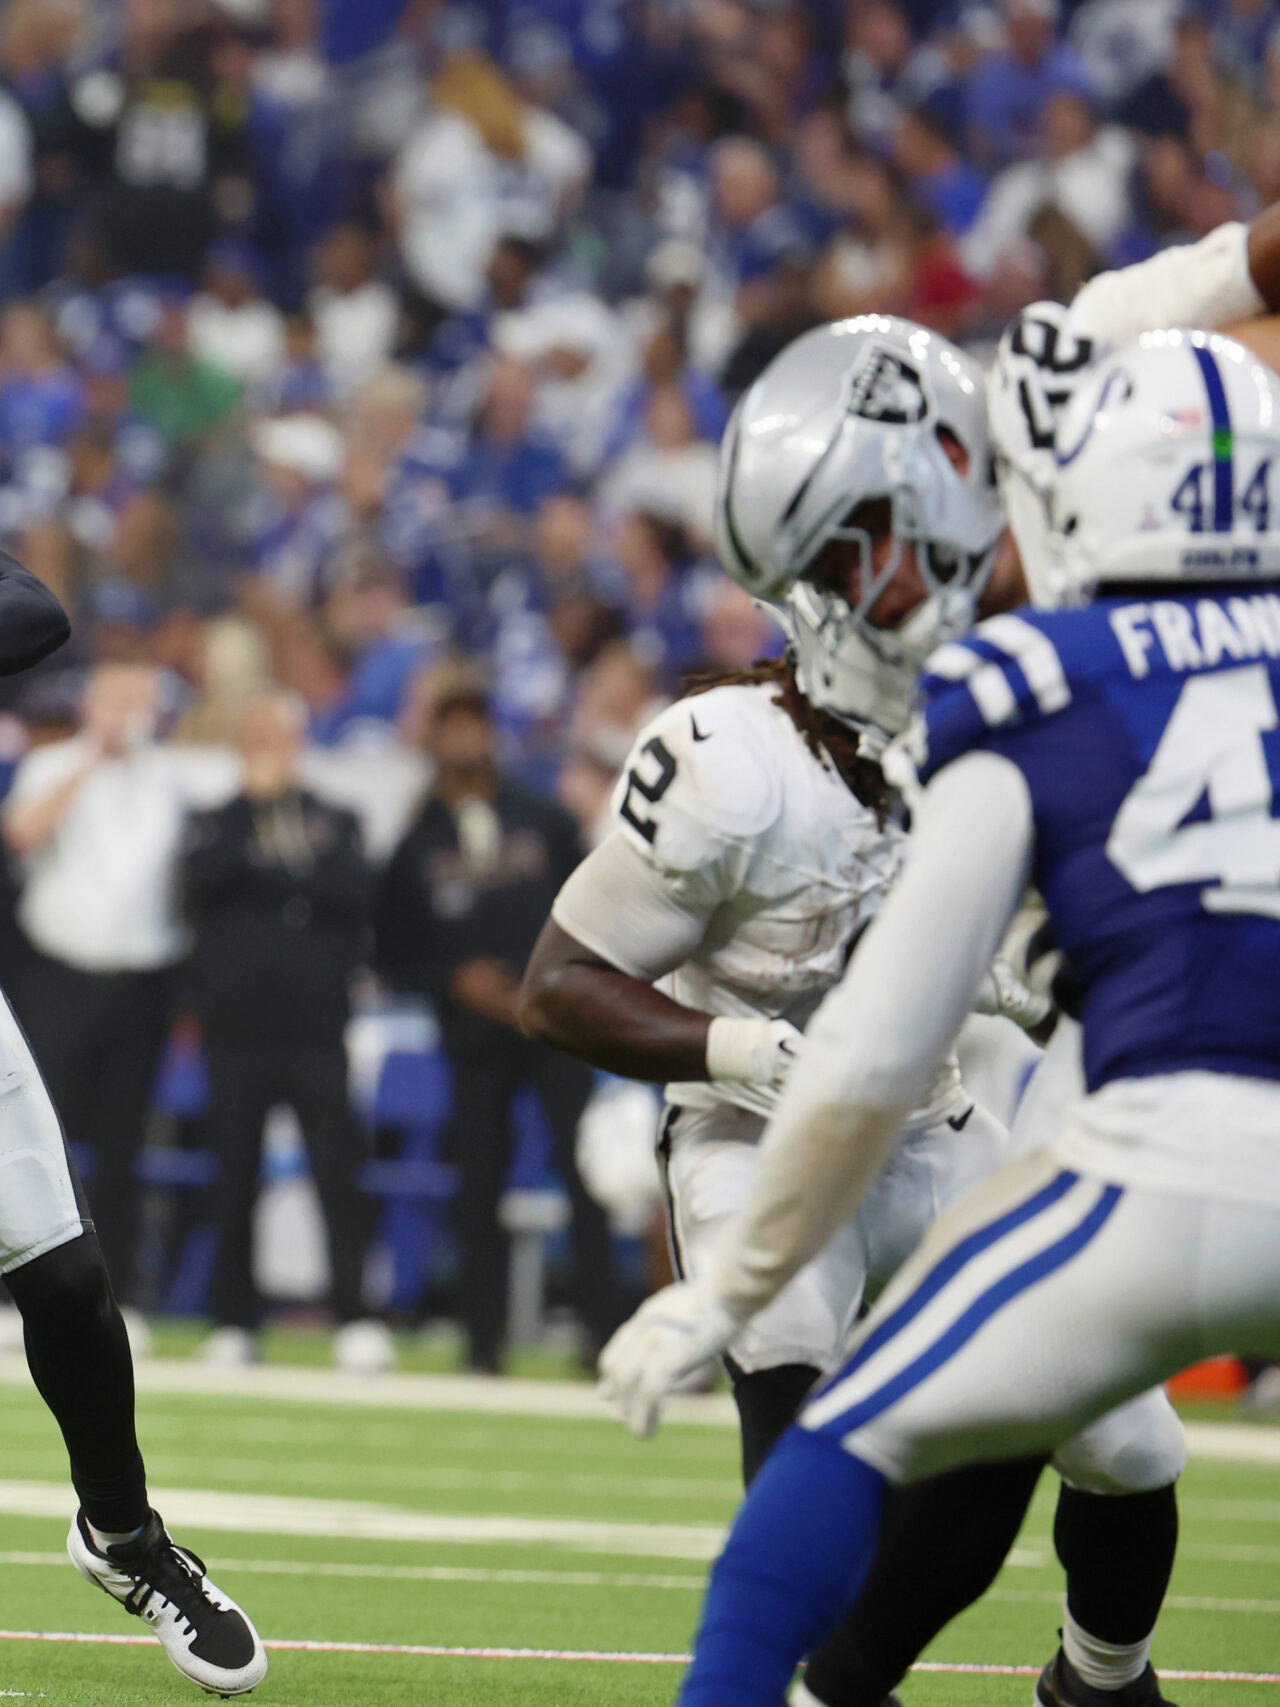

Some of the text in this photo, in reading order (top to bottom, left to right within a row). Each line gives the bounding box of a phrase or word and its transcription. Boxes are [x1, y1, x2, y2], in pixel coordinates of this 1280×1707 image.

[1171, 457, 1272, 533] 44
[619, 736, 677, 845] 2
[1105, 663, 1280, 920] 4
